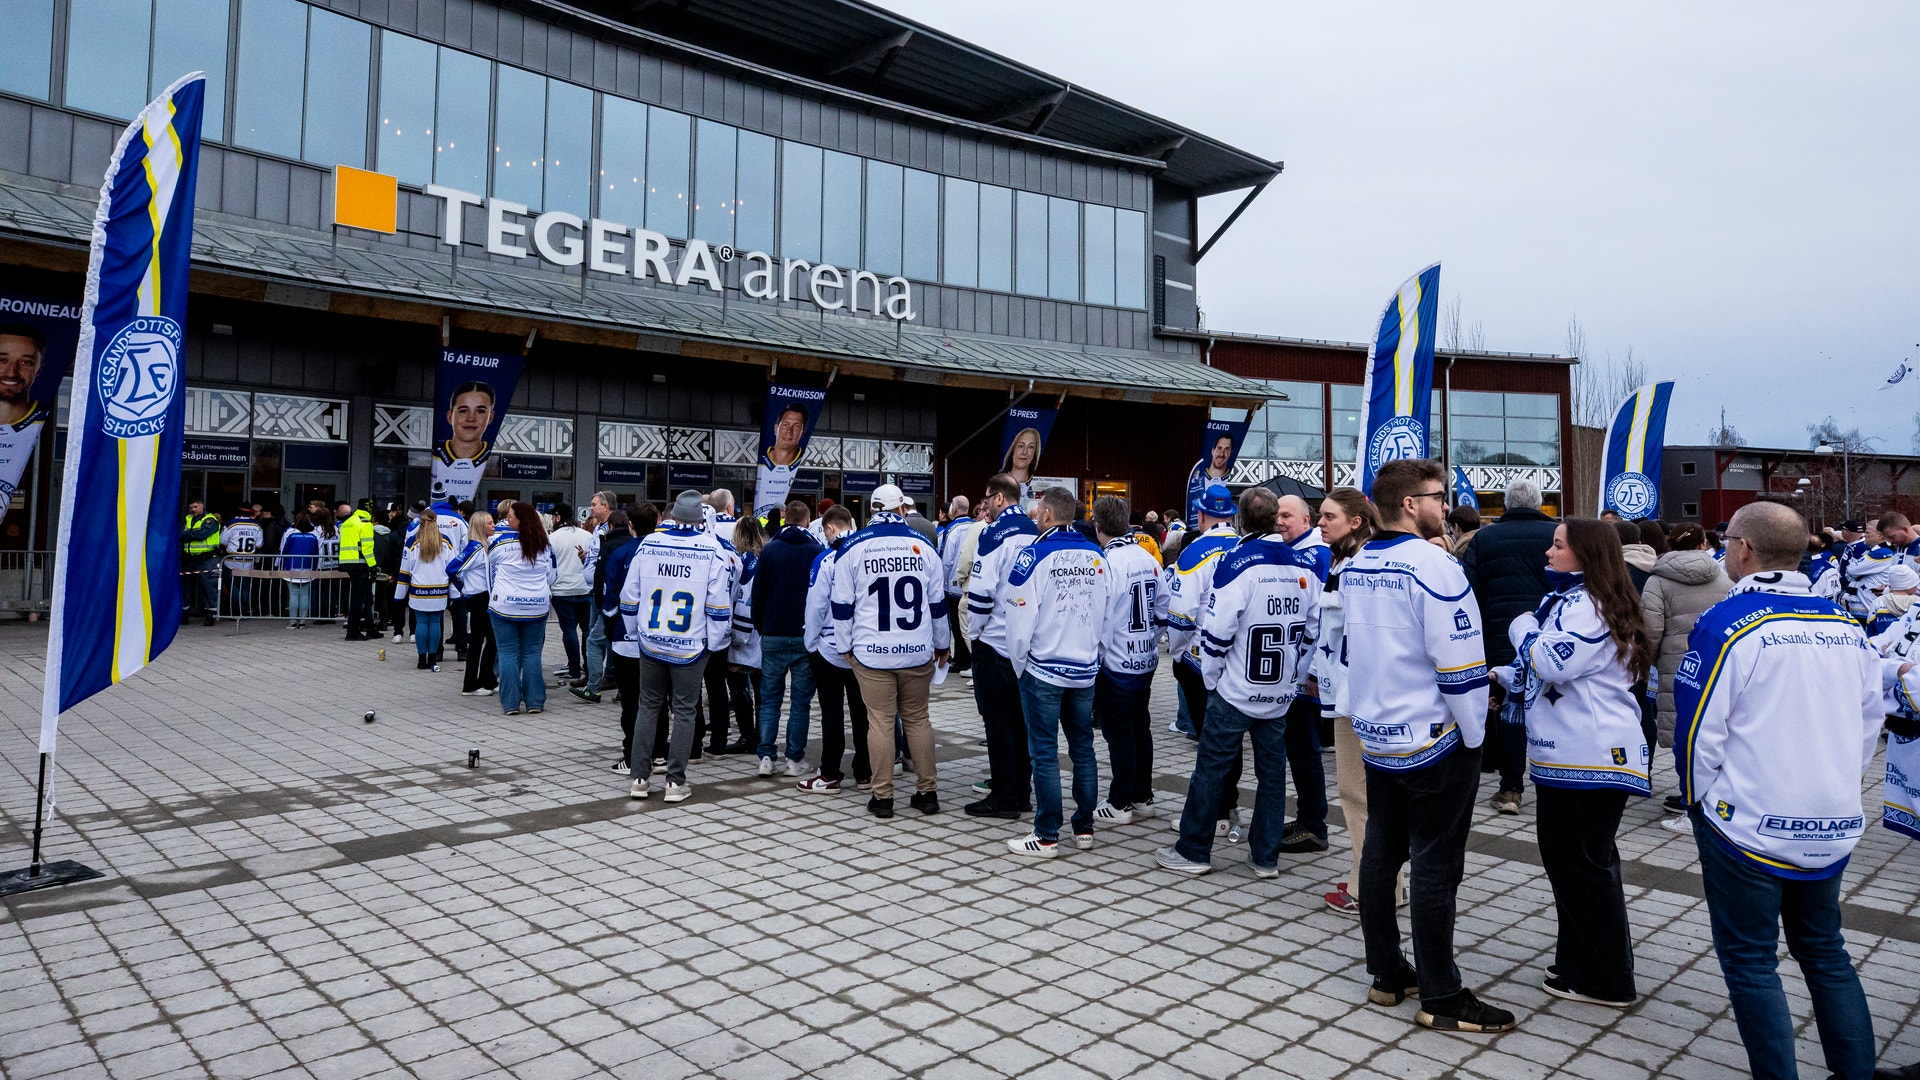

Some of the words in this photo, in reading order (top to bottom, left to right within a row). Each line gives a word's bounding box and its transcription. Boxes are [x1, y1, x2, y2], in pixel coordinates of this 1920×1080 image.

[740, 250, 916, 321] arena
[443, 351, 455, 362] 16
[456, 354, 472, 364] AF
[472, 356, 499, 368] BJUR
[770, 386, 777, 395] 9
[777, 387, 826, 400] ZACKRISSON
[1010, 409, 1017, 417] 15
[1017, 410, 1039, 419] PRESS
[181, 452, 217, 461] Ståplats
[219, 454, 247, 462] mitten
[581, 510, 587, 518] 4
[236, 537, 256, 553] 16
[642, 547, 676, 557] Leksands
[676, 550, 711, 560] Sparbank
[1017, 553, 1033, 568] NS
[658, 563, 692, 578] KNUTS
[864, 556, 923, 575] FORSBERG
[1050, 566, 1096, 578] TORAENSO
[1391, 561, 1416, 573] TEGERA
[868, 575, 923, 632] 19
[648, 588, 695, 634] 13
[1731, 606, 1774, 630] TEGERA
[1457, 616, 1470, 628] NS
[1449, 629, 1481, 642] Skoglunds
[866, 643, 889, 654] clas
[891, 643, 926, 654] ohlson
[1127, 641, 1138, 654] M.
[1556, 643, 1570, 657] NS
[1122, 658, 1146, 671] clas
[1683, 660, 1697, 674] NS
[1675, 673, 1702, 690] oglunds
[1248, 693, 1275, 704] clas
[1352, 717, 1406, 736] BOLAGET
[1765, 817, 1864, 832] ELBOLAGET
